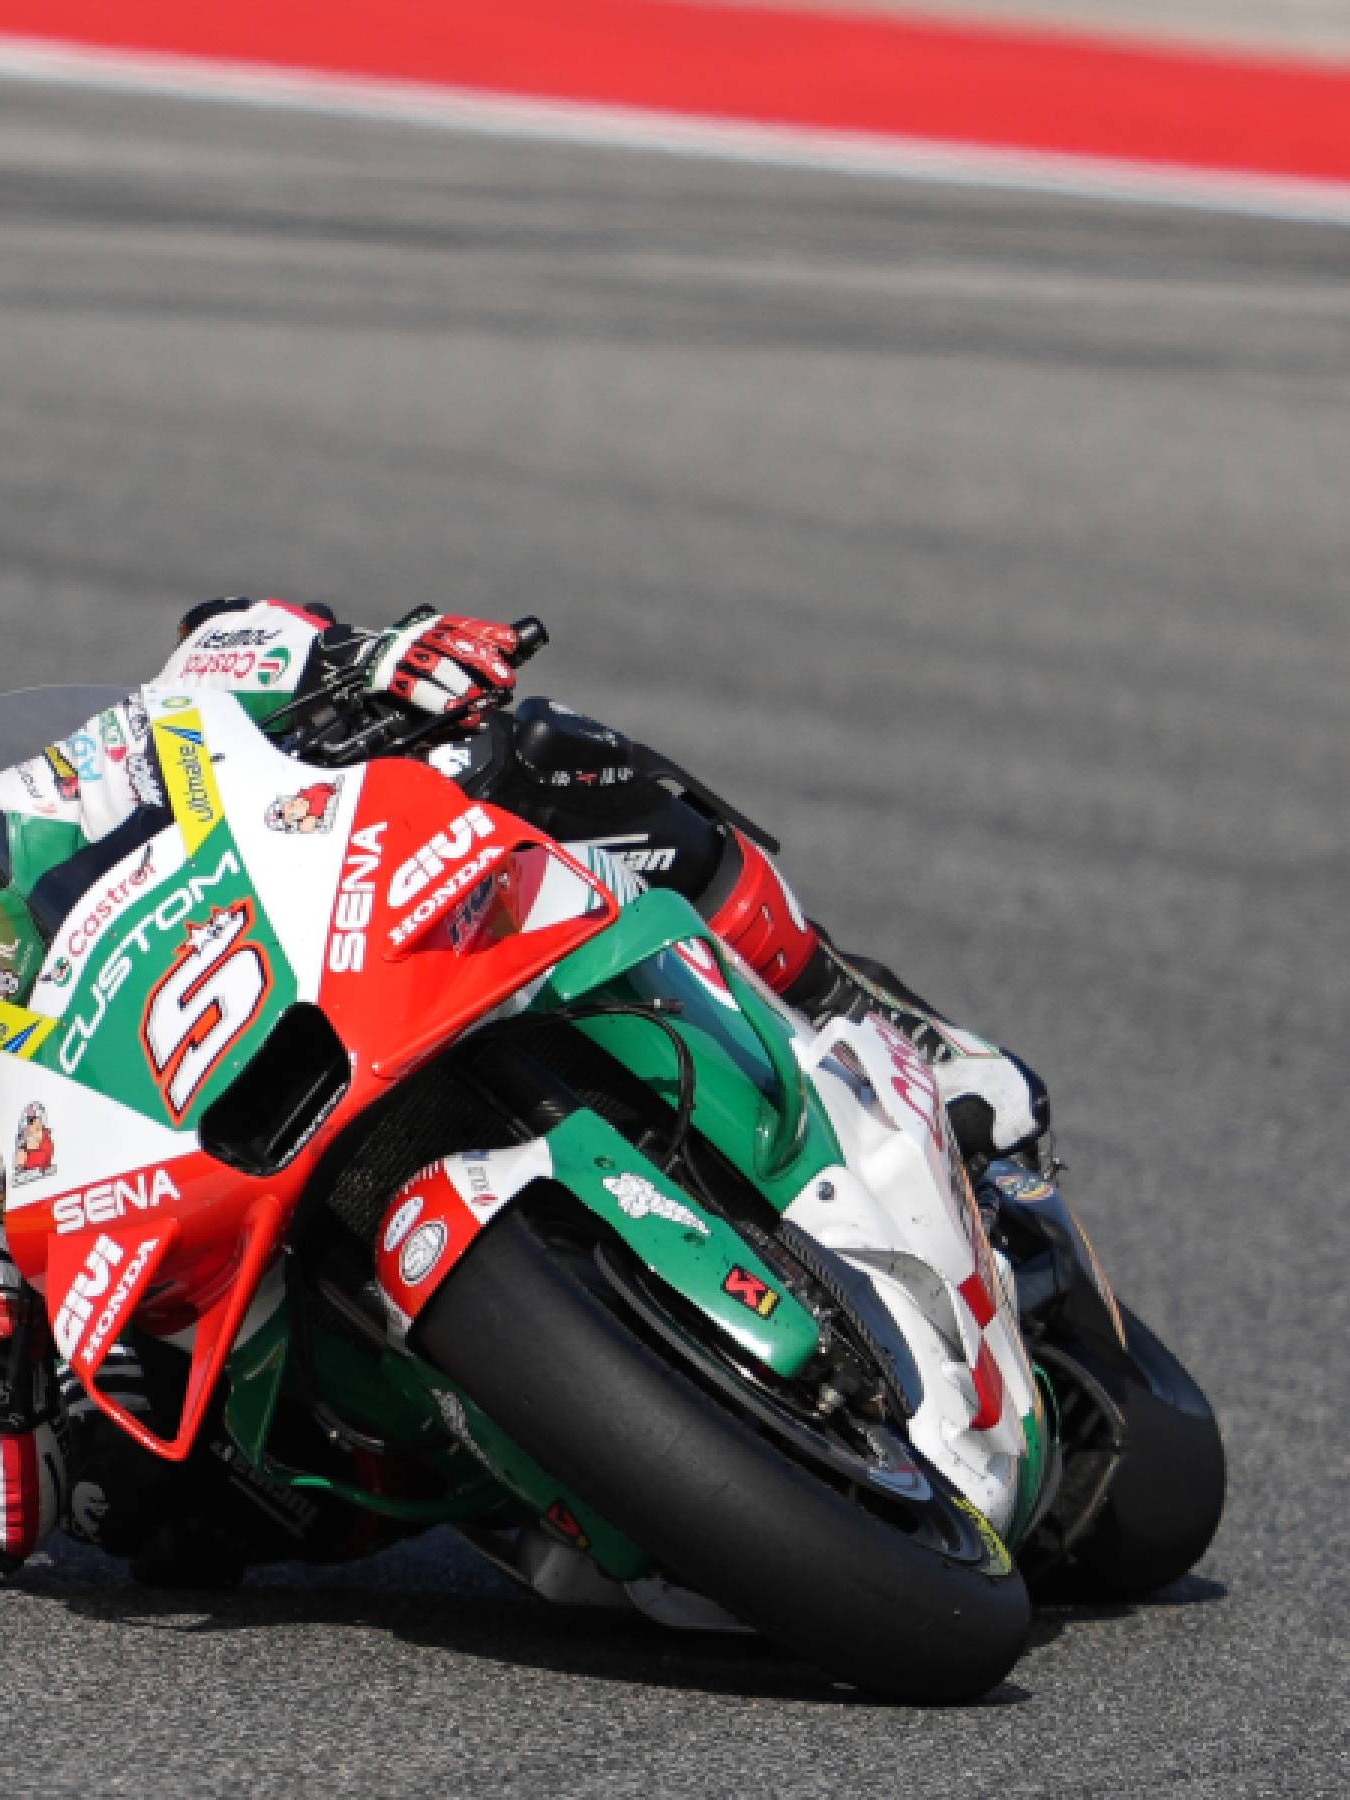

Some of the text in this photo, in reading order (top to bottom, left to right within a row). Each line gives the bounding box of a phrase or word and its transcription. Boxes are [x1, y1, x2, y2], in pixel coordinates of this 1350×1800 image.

[330, 821, 388, 972] SENA
[387, 806, 496, 907] GIVI
[389, 846, 505, 945] HONDA
[60, 850, 240, 1074] CUSTOM
[53, 1170, 181, 1235] SENA
[55, 1233, 125, 1354] GIVI
[83, 1238, 158, 1363] HONDA
